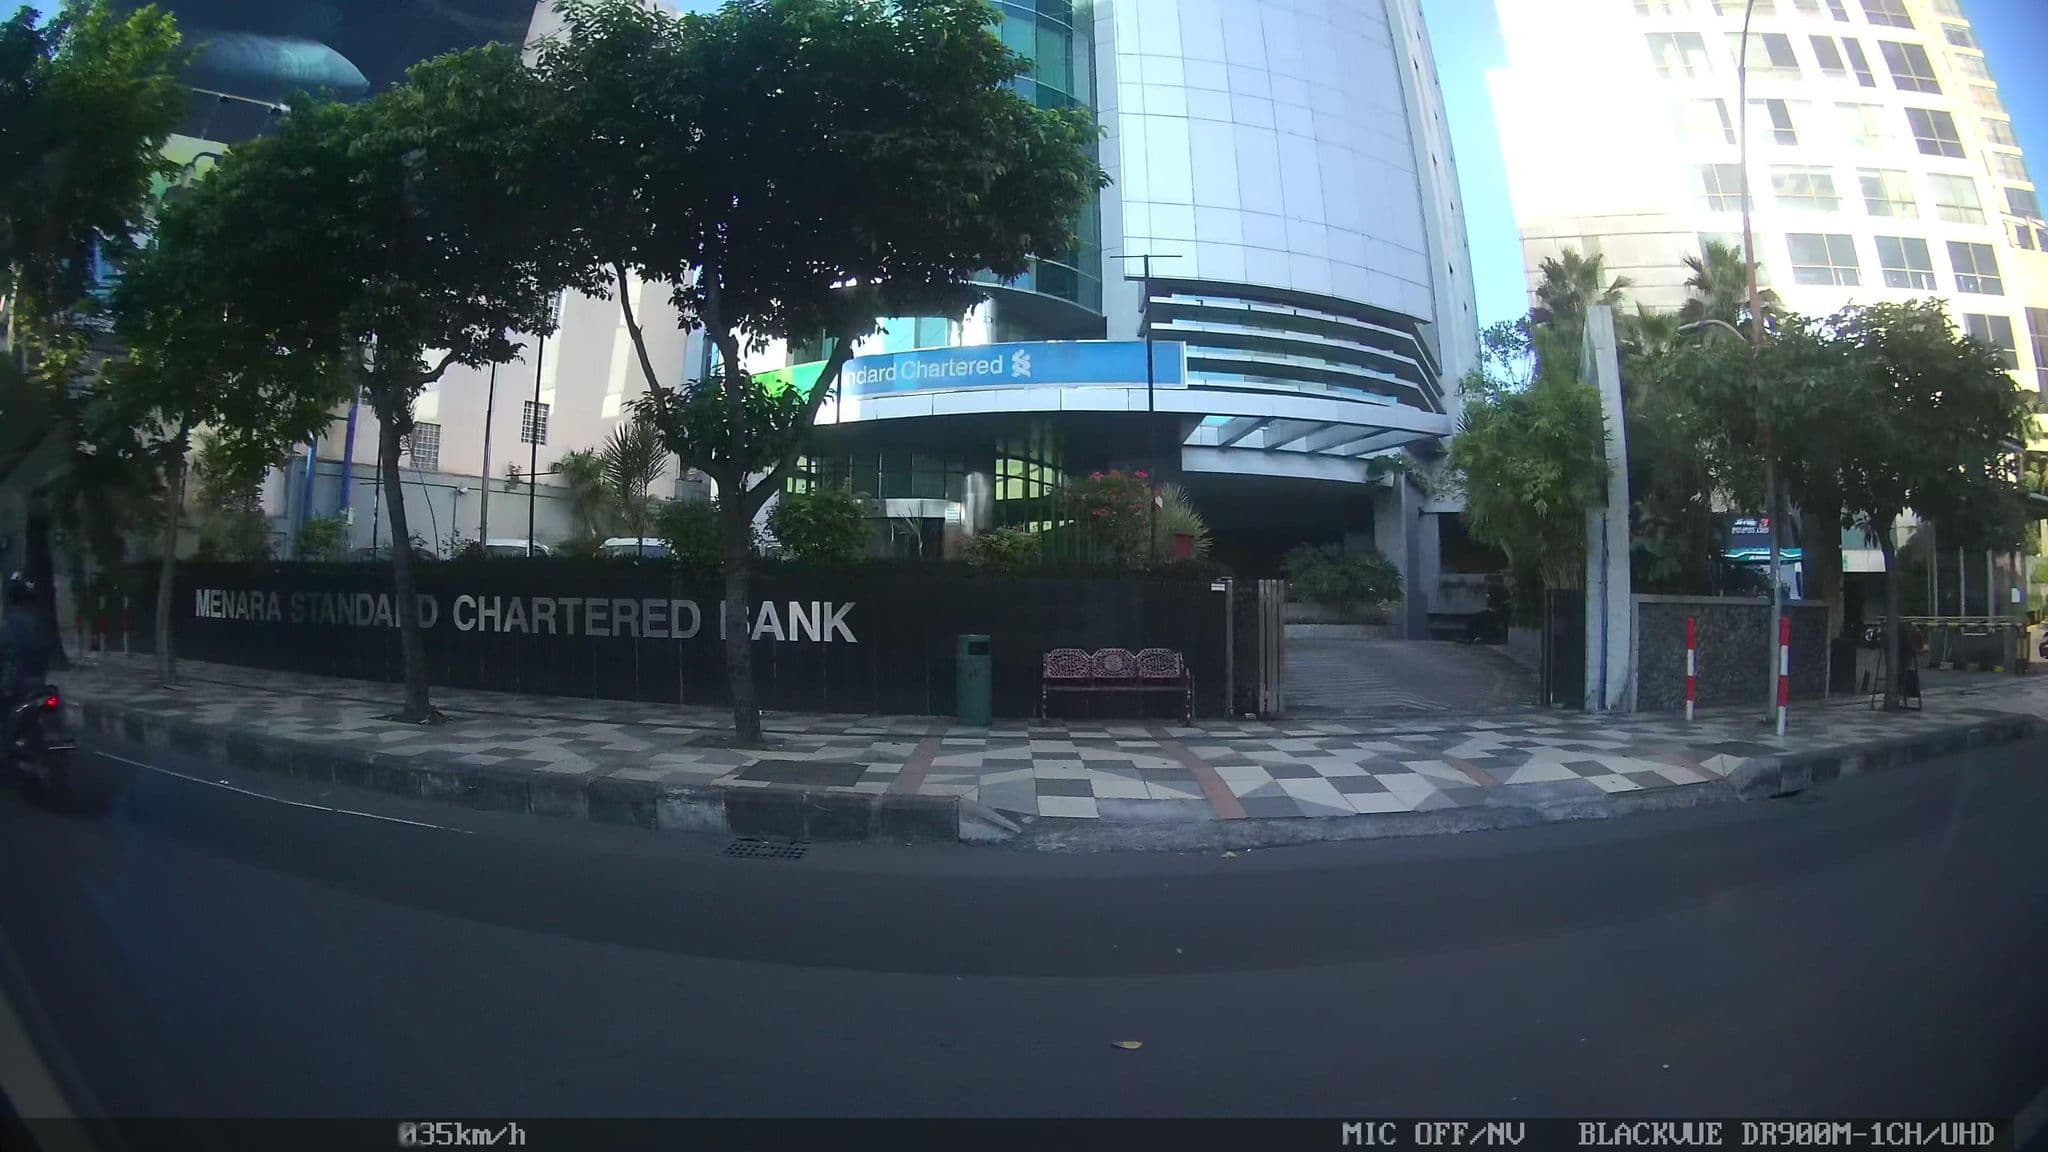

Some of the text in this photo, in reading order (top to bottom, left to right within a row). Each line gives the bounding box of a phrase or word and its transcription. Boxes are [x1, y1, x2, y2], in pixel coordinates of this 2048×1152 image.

[901, 354, 1003, 381] Chartered
[195, 588, 282, 622] MENARA
[452, 594, 701, 639] CHARTERED
